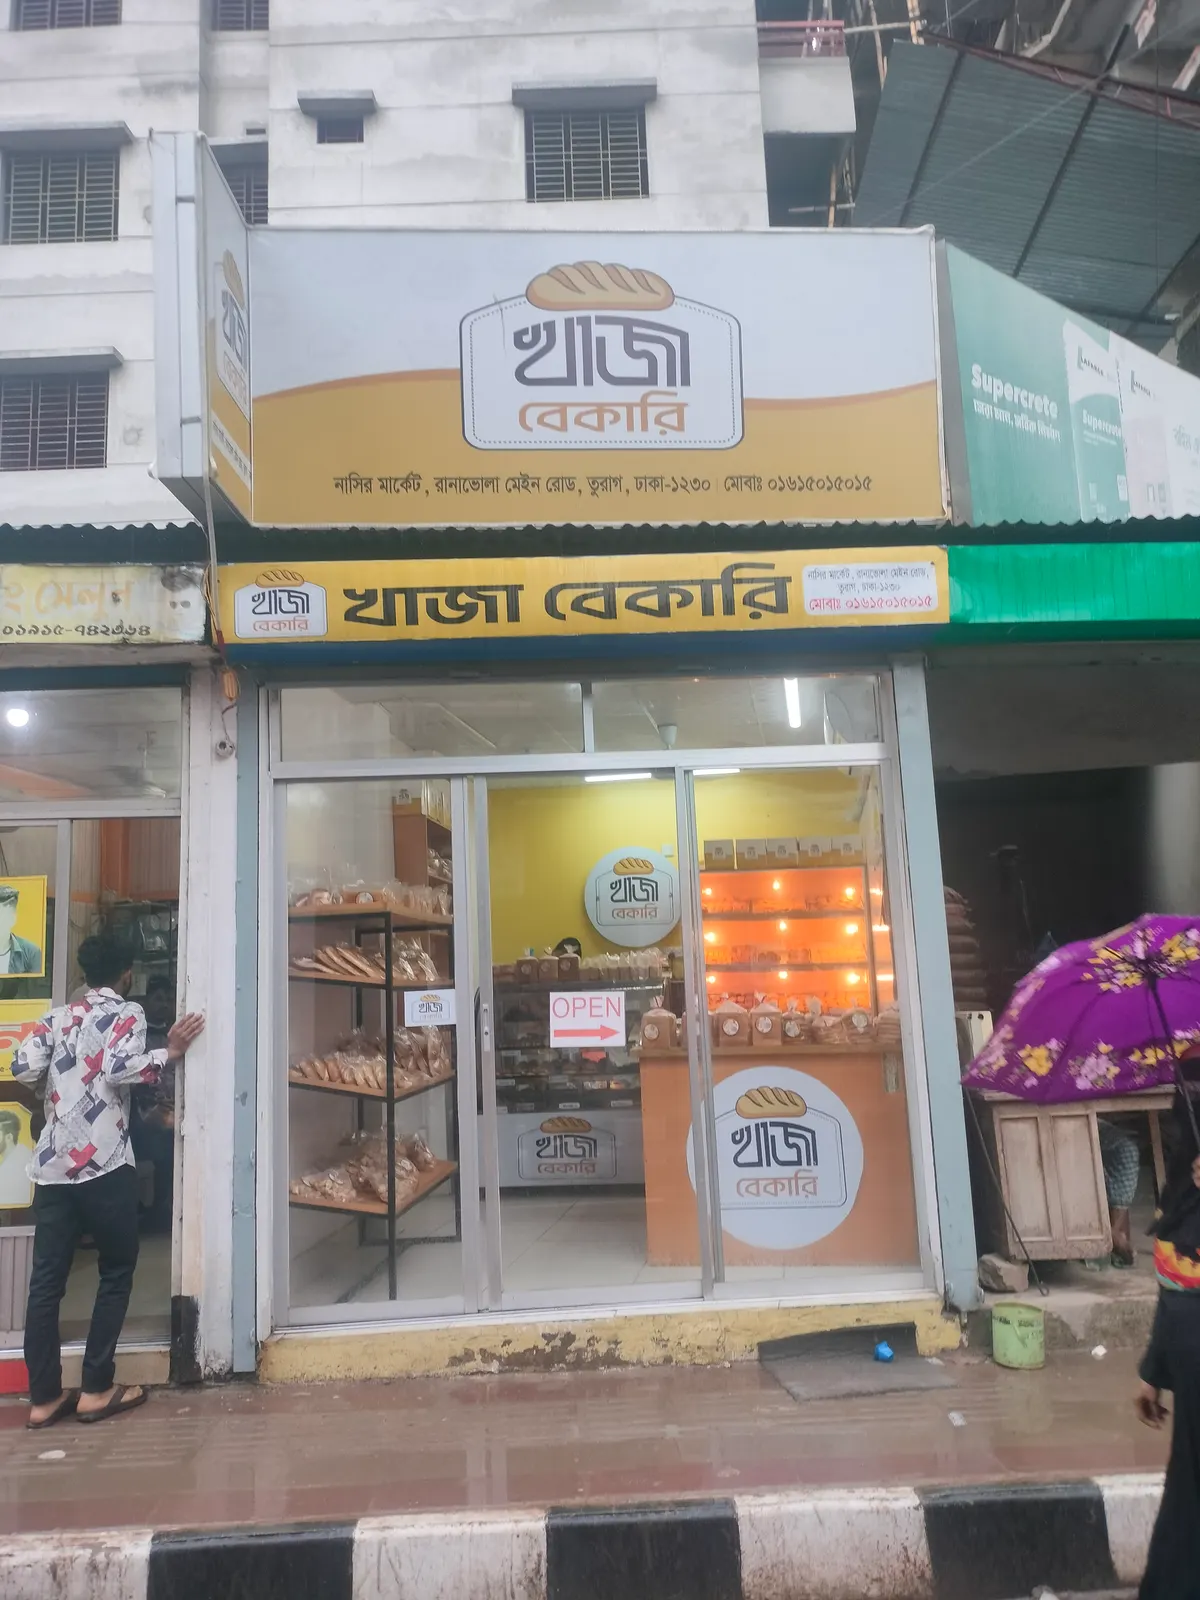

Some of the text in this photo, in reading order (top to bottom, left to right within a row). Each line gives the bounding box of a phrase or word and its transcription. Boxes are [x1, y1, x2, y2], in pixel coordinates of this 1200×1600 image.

[513, 315, 691, 387] খাজা
[971, 363, 1058, 419] Supercrete
[518, 390, 689, 435] বেকারি
[333, 471, 373, 494] নাসির
[433, 475, 500, 494] রানাভোলা
[505, 471, 541, 494] মেইন
[634, 475, 711, 494] ঢাকা-১২৩০
[767, 475, 872, 493] ০১৬১৫০১৫০১৫
[252, 589, 309, 615] খাজা
[343, 562, 792, 626] খাজা বেকারি
[845, 595, 933, 609] ০১৬১৫০১৫০১৫
[253, 616, 309, 632] বেকারি
[610, 876, 659, 903] খাজা
[611, 903, 658, 920] বেকারি
[552, 996, 621, 1018] OPEN
[536, 1134, 597, 1158] খাজা
[731, 1121, 818, 1168] খাজা
[538, 1159, 596, 1175] বেকারি
[736, 1168, 818, 1198] বেকারি
